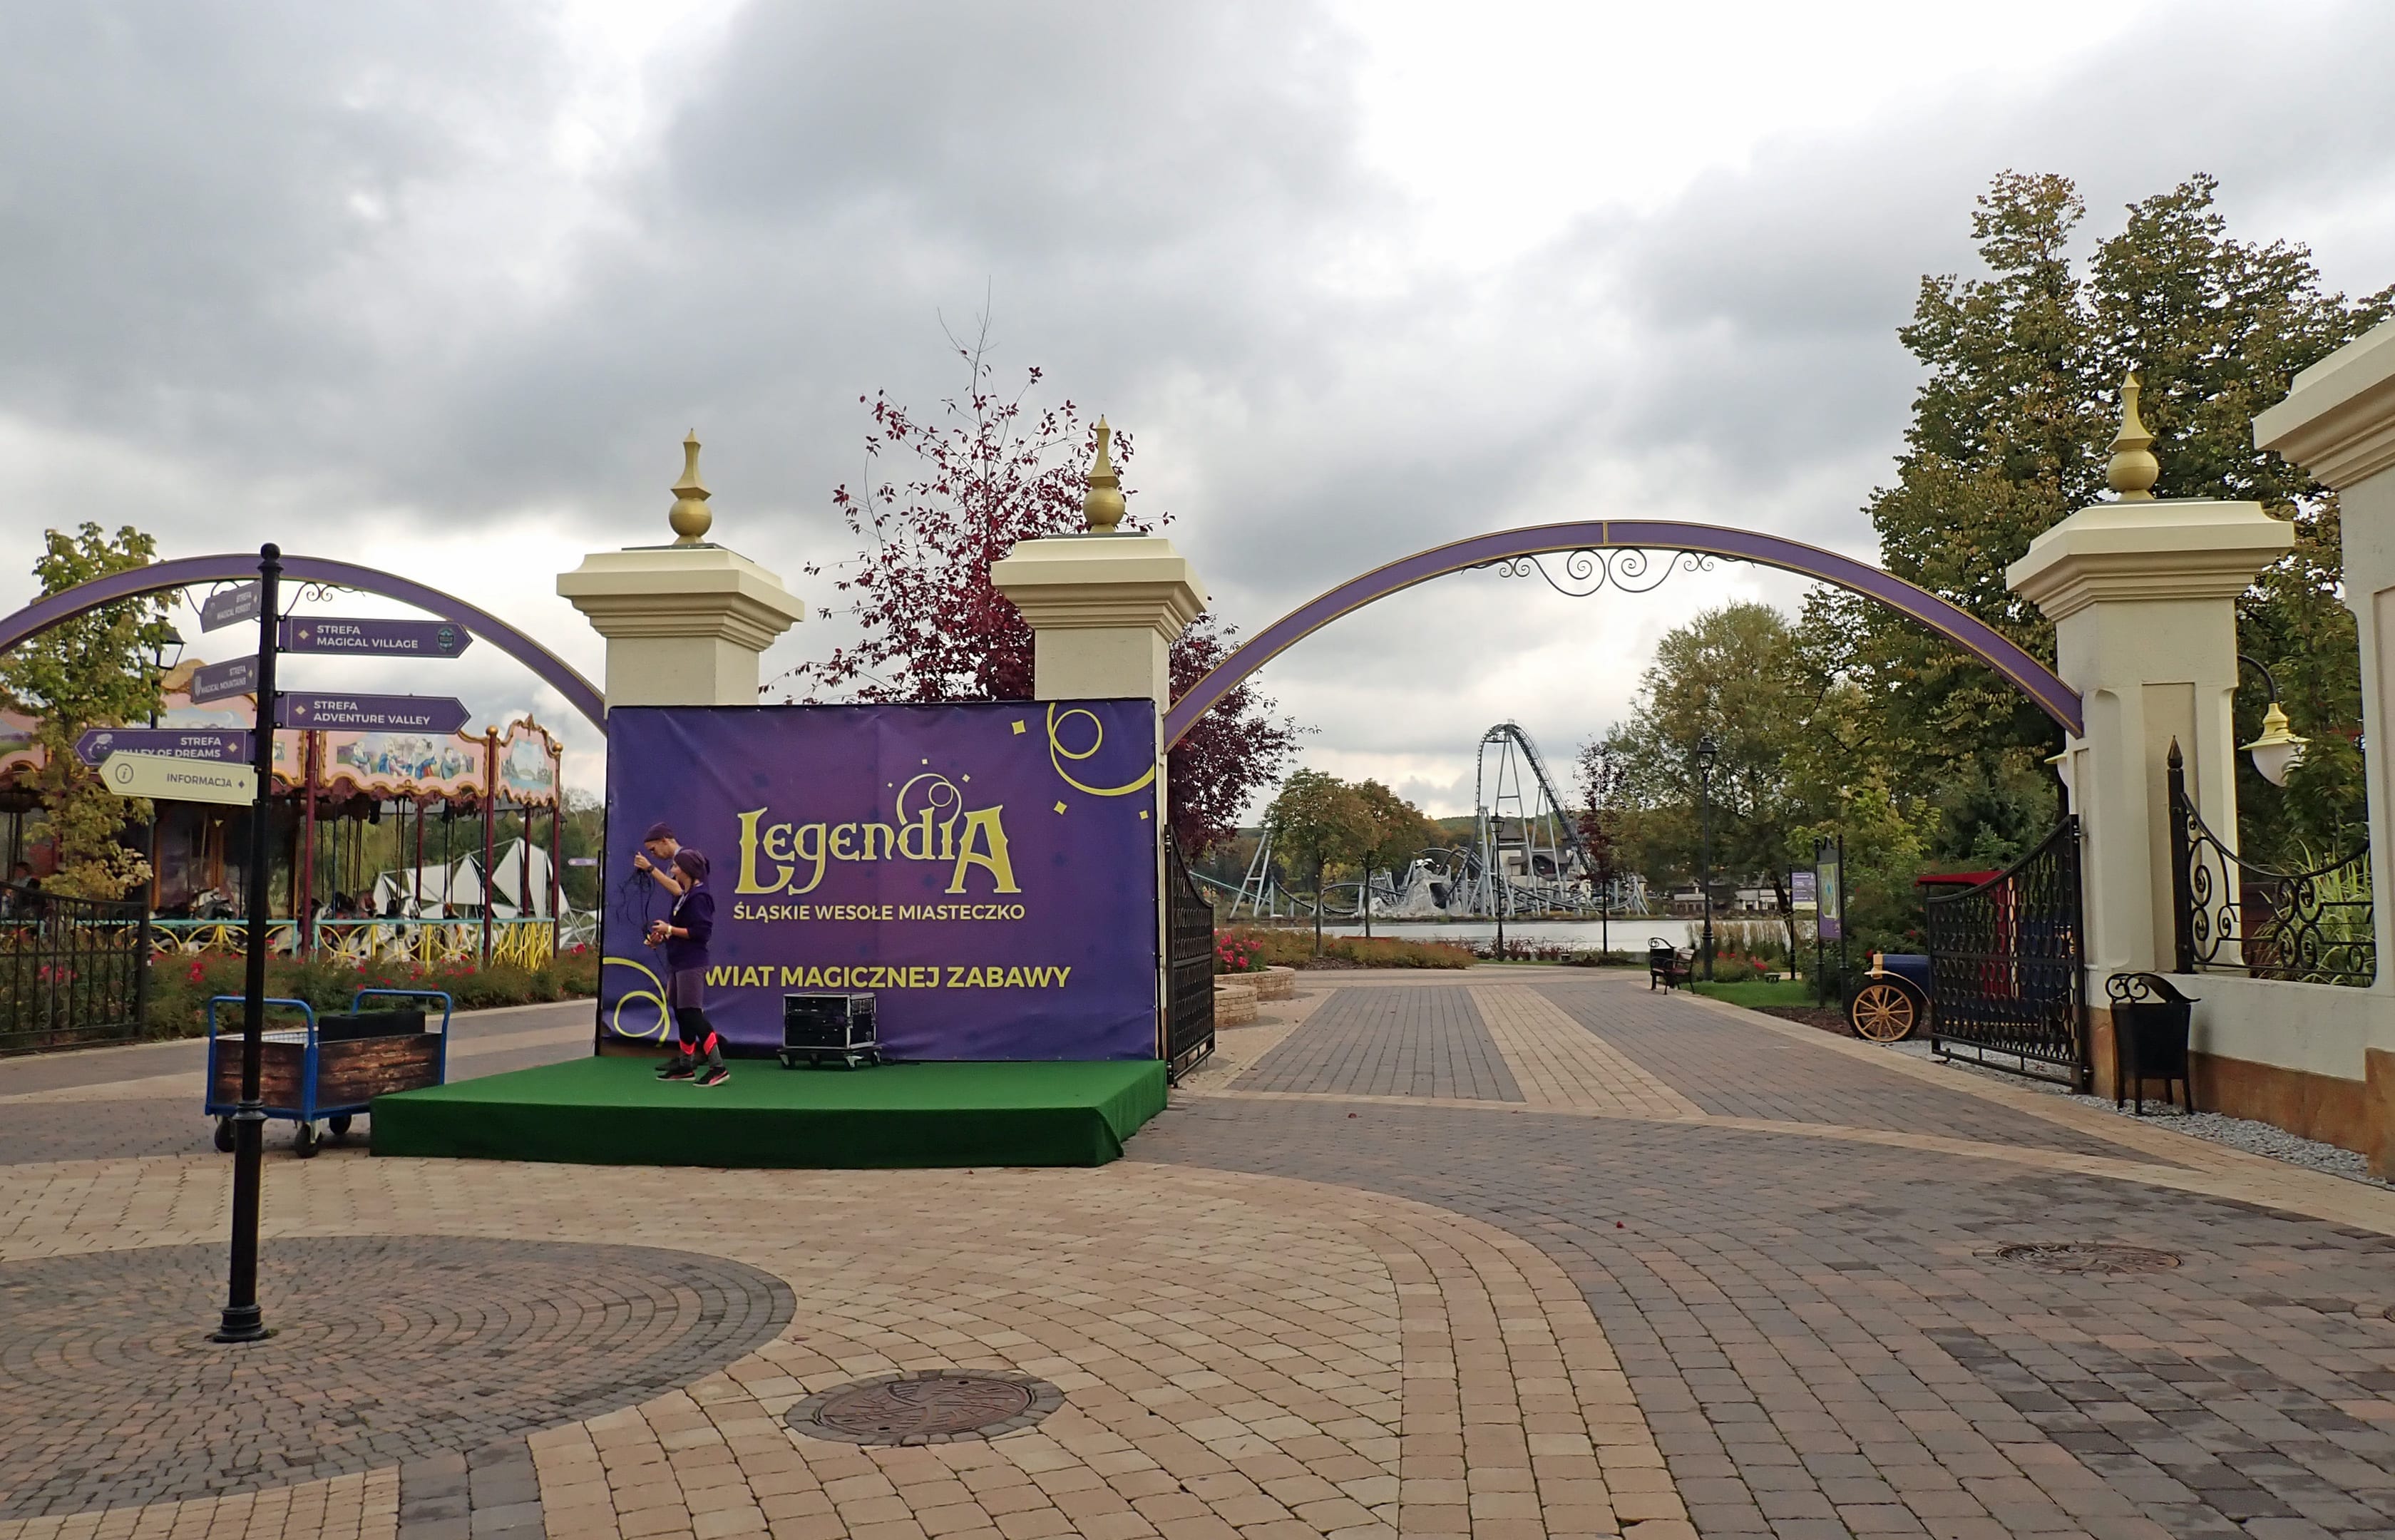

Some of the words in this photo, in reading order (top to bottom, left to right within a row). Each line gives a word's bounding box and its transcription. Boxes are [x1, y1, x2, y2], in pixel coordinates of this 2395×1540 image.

[317, 625, 361, 635] STREFA
[317, 637, 369, 647] MAGICAL
[372, 639, 419, 649] VILLAGE
[313, 700, 358, 711] STREFA
[313, 713, 385, 724] ADVENTURE
[389, 715, 430, 726] VALLEY
[180, 736, 222, 746] STREFA
[157, 749, 172, 757] OF
[175, 749, 221, 758] DREAMS
[166, 772, 232, 788] INFORMACJA
[733, 901, 810, 923] ŚLĄSKIE
[815, 903, 893, 921] WESOŁE
[898, 903, 1025, 921] MIASTECZKO
[704, 965, 775, 987] WIAT
[781, 965, 940, 988] MAGICZNEJ
[946, 966, 1072, 988] ZABAWY
